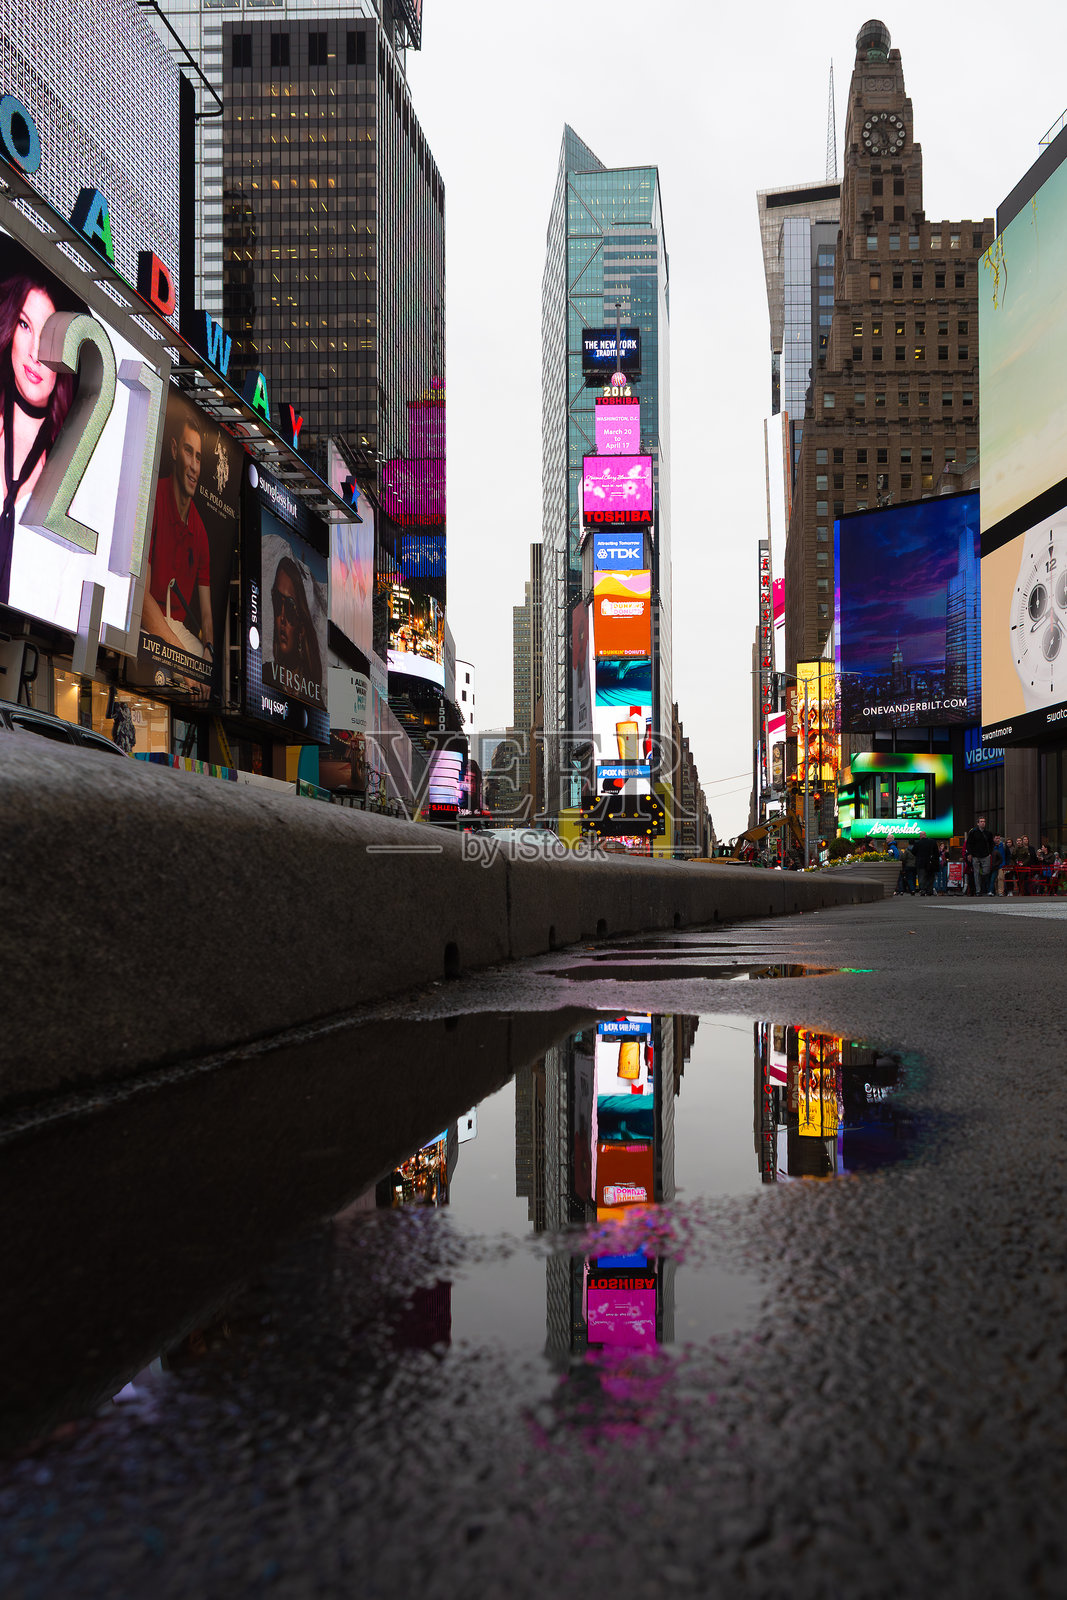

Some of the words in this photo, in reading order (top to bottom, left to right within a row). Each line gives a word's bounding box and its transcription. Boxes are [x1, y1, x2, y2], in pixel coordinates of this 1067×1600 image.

[584, 340, 598, 348] THE
[600, 340, 616, 348] NEW
[603, 386, 632, 396] 2016
[210, 492, 223, 508] POLO
[286, 496, 298, 518] hut
[585, 511, 652, 522] TOSHIBA
[607, 548, 640, 558] TDK
[1045, 558, 1057, 573] 12
[143, 638, 160, 655] LIVE
[162, 646, 213, 676] AUTHENTICALLY
[272, 662, 320, 700] VERSACE
[862, 698, 968, 716] ONEVANDERBILT.COM
[982, 726, 1012, 741] swantmore
